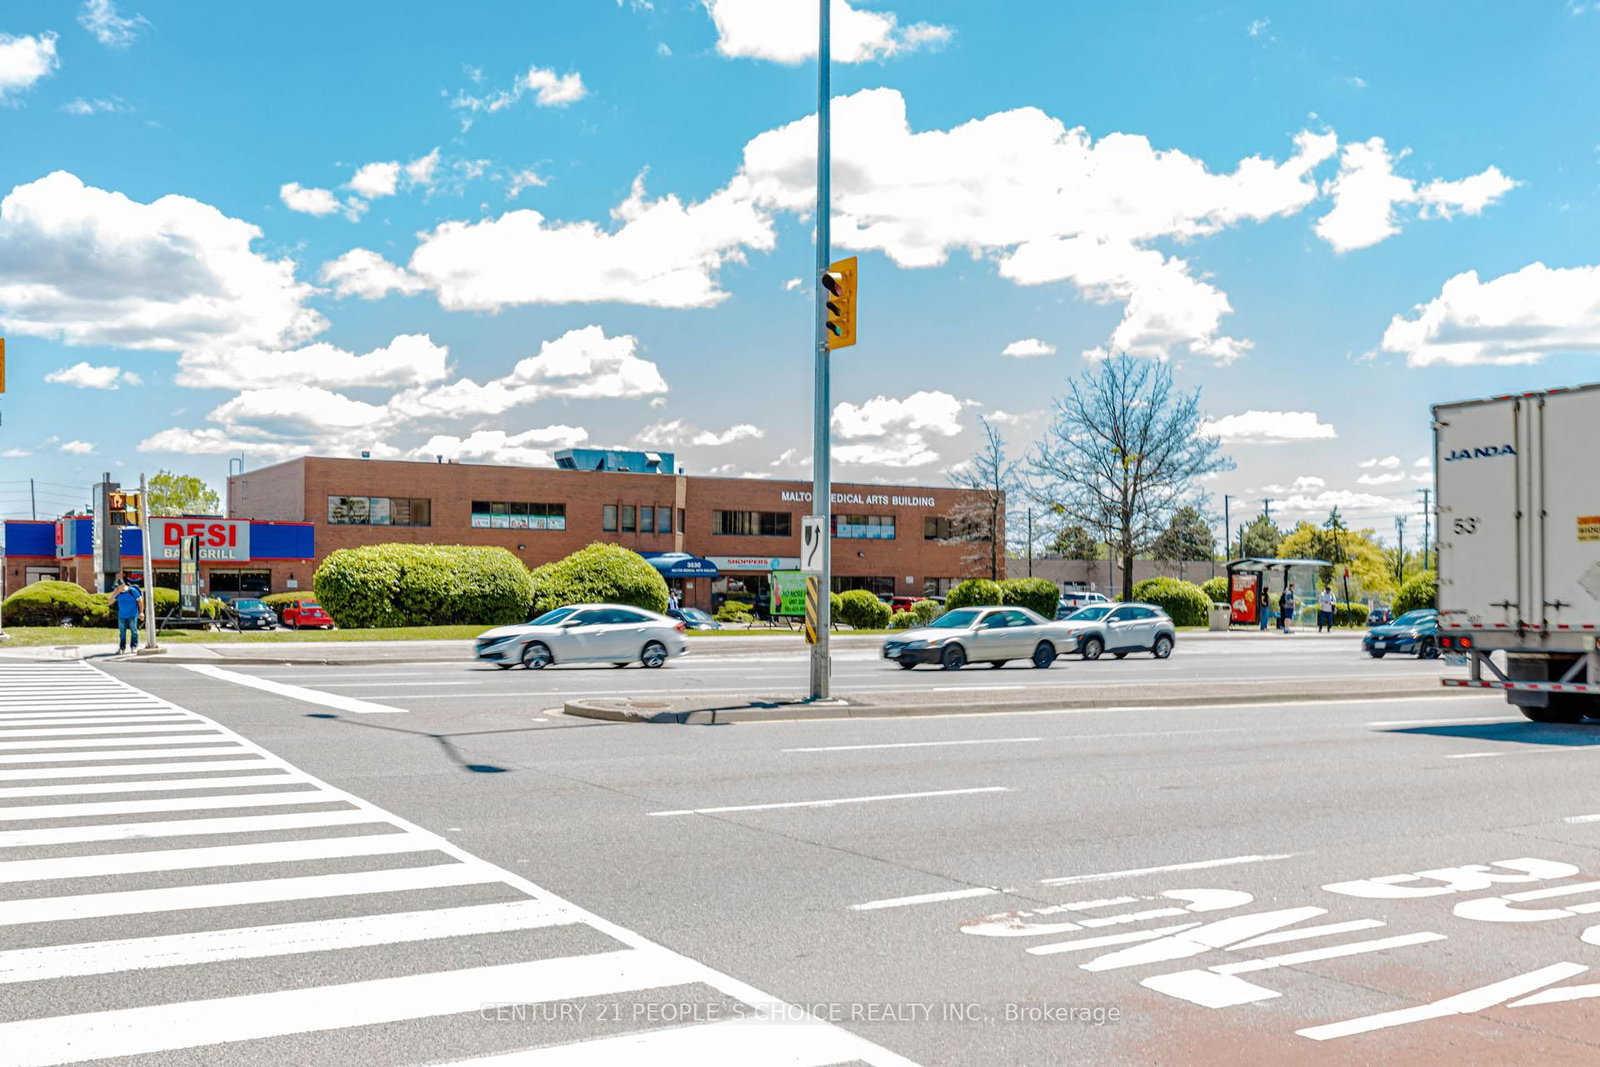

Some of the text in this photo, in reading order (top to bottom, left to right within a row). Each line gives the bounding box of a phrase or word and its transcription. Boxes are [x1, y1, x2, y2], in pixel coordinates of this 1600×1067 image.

[1444, 444, 1518, 462] JANDA
[781, 491, 935, 507] MALTO EDICAL ARTS BUILDING
[164, 523, 237, 547] DESI
[164, 548, 236, 559] BA GRILL
